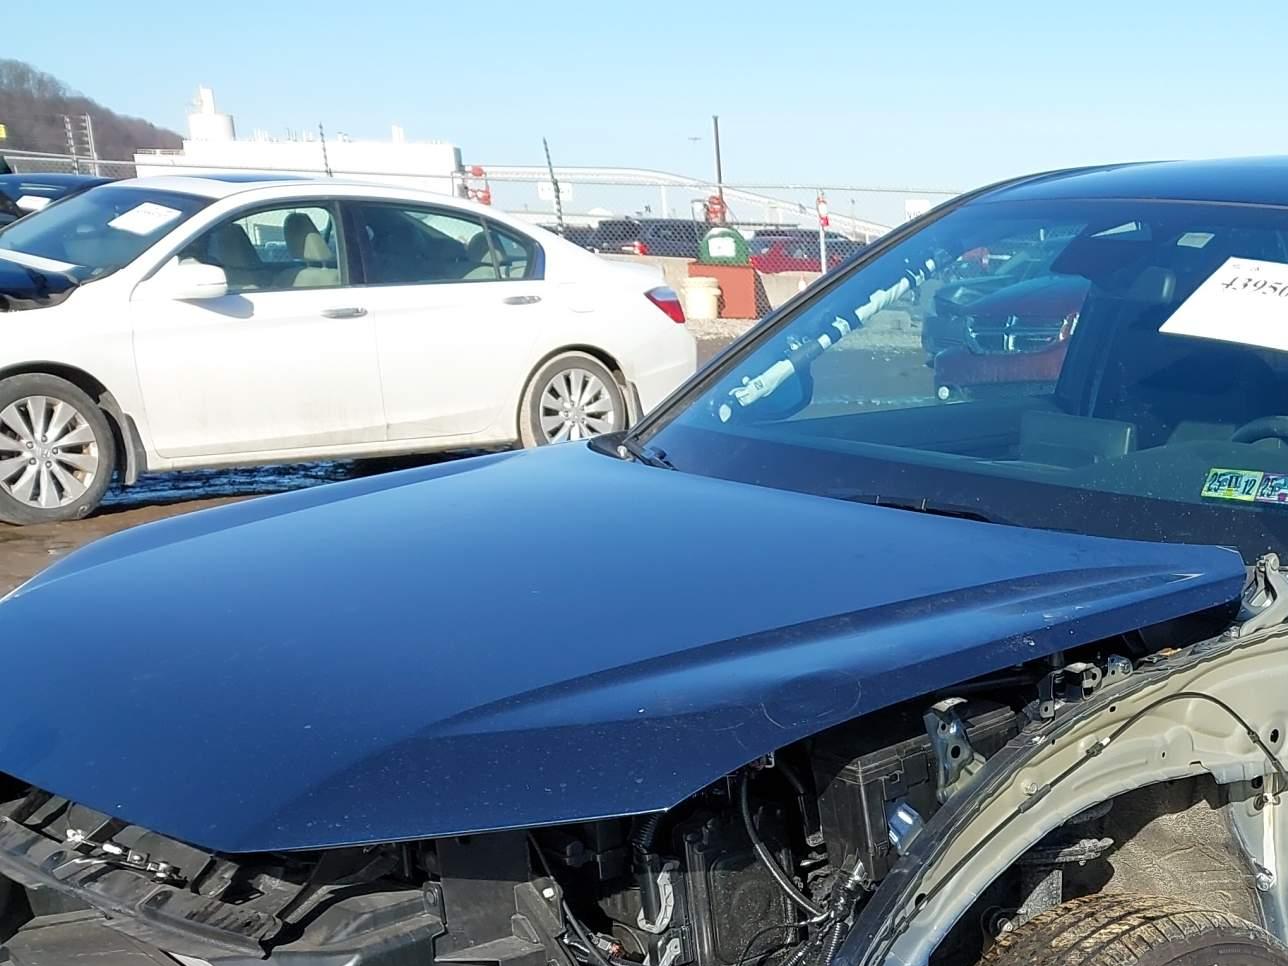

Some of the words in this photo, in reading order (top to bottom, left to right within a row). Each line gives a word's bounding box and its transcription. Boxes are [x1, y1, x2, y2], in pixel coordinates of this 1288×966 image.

[1208, 471, 1223, 493] 25
[1242, 479, 1257, 496] 12
[1260, 477, 1277, 498] 25
